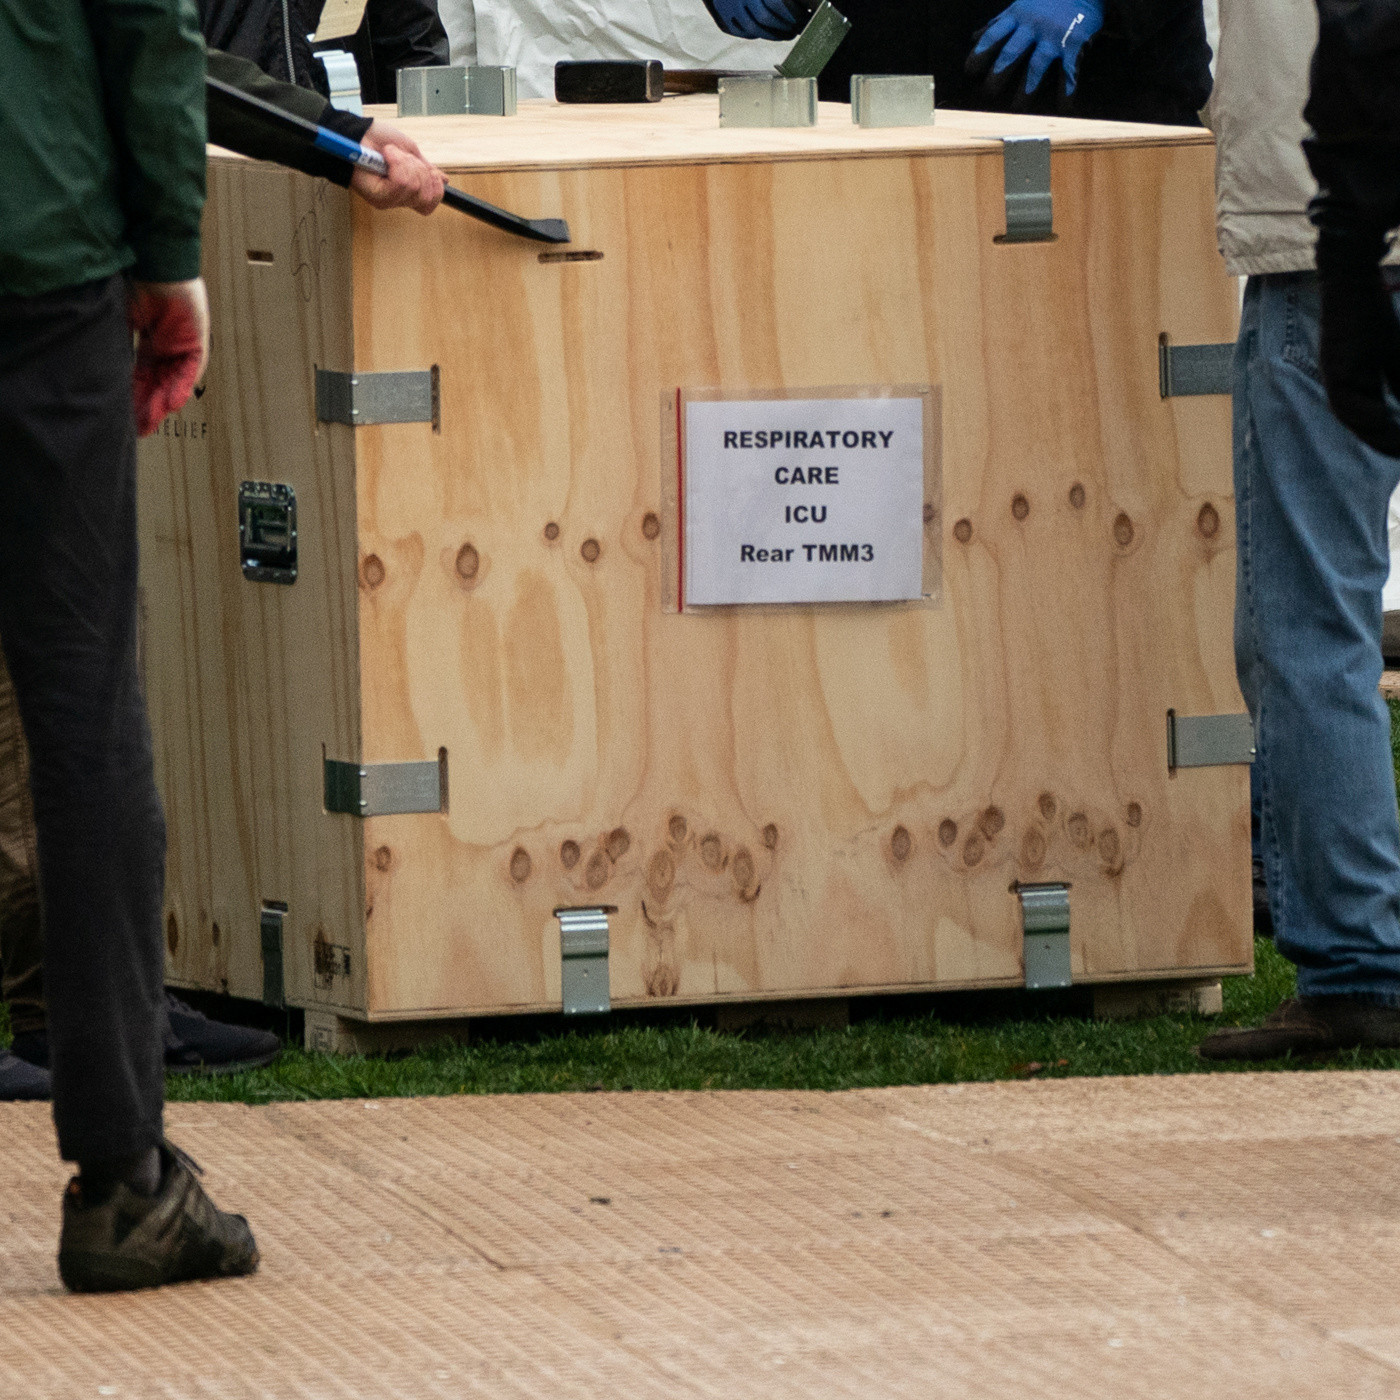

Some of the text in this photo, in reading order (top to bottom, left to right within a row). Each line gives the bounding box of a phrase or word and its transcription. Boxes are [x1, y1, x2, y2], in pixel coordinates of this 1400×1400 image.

[153, 418, 207, 439] ELIEF
[723, 430, 894, 449] RESPIRATORY
[774, 466, 839, 485] CARE
[784, 505, 828, 524] ICU
[740, 544, 875, 563] Rear TMM3
